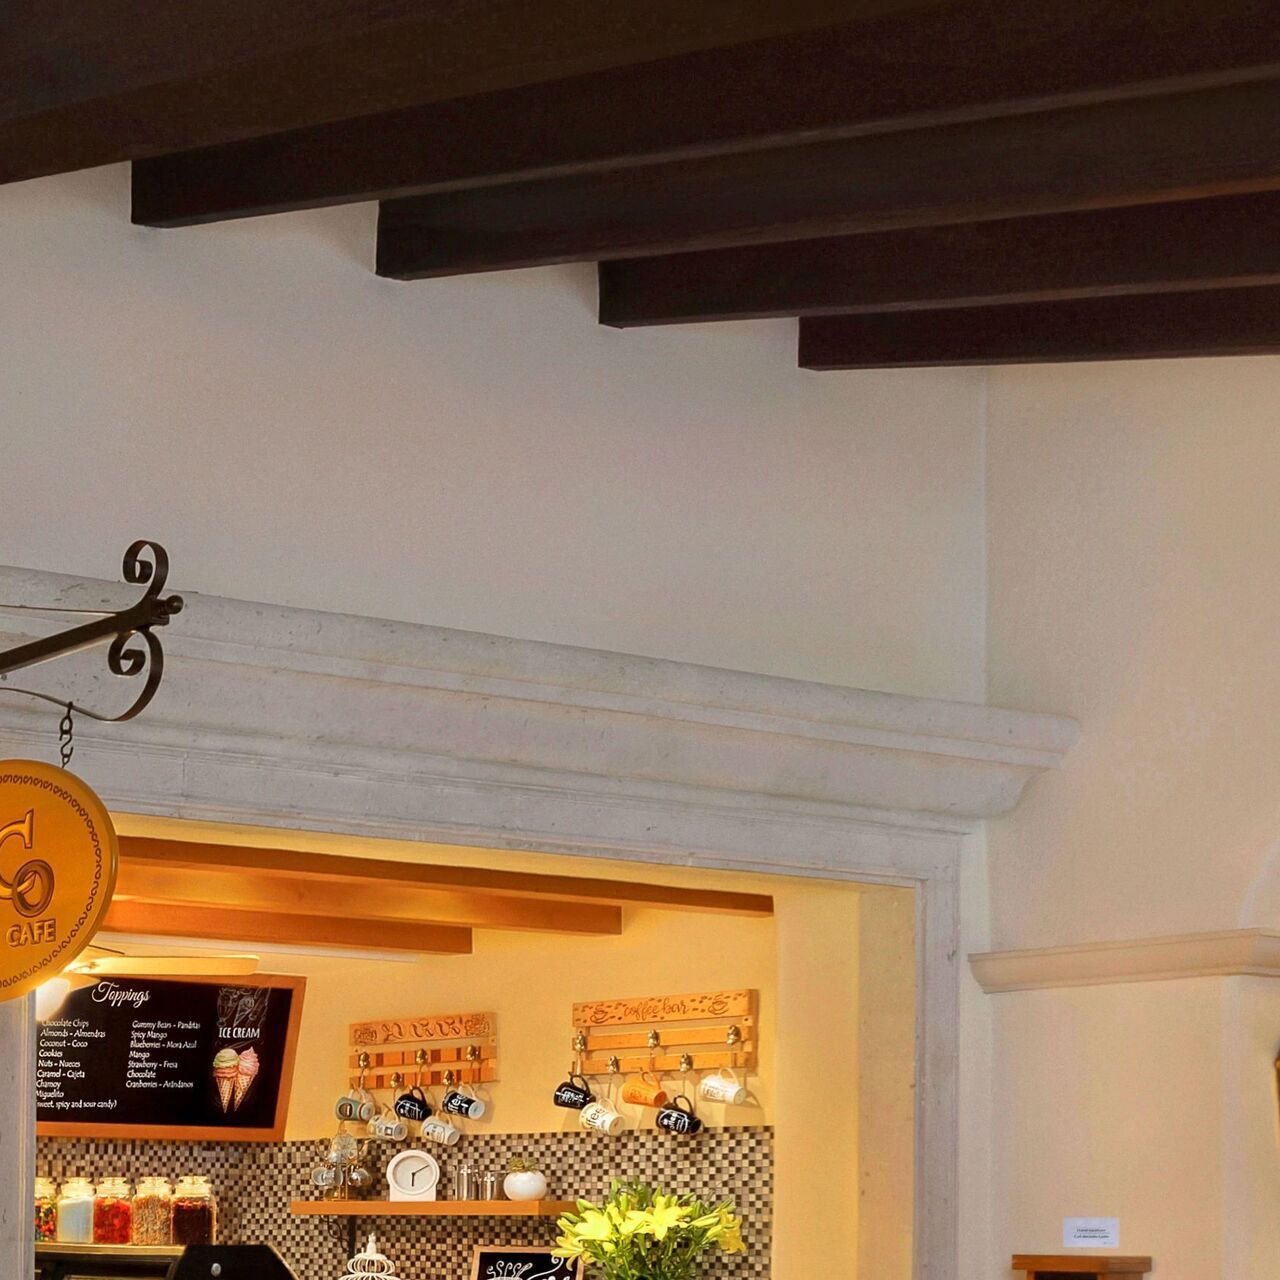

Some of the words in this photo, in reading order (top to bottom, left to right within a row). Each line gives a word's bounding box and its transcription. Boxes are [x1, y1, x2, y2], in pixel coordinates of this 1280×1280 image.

[6, 918, 56, 947] CAFE
[91, 981, 150, 1008] Toppings
[663, 998, 689, 1015] bar
[218, 1027, 232, 1039] ICE
[233, 1027, 260, 1039] CREAM
